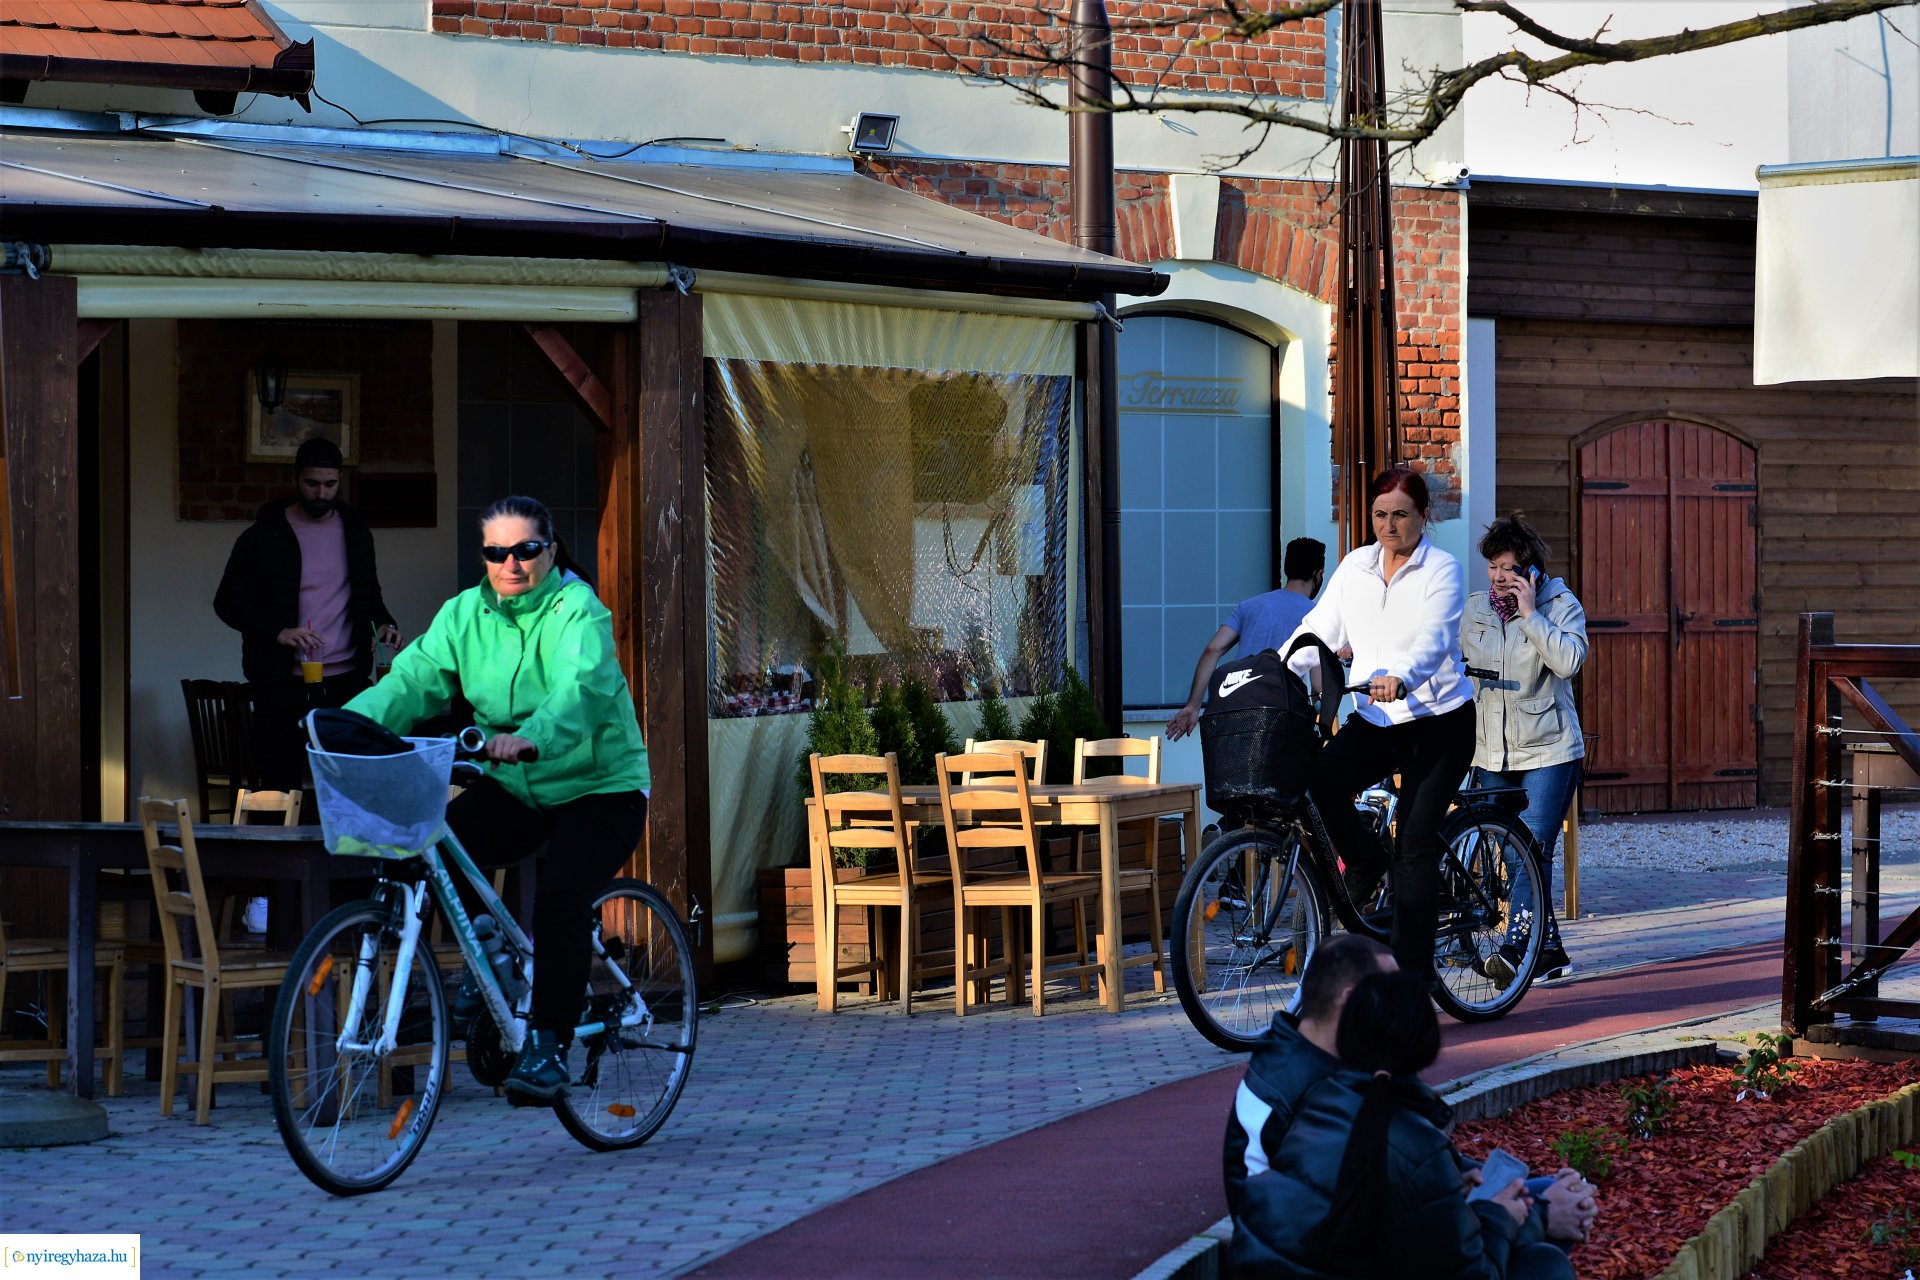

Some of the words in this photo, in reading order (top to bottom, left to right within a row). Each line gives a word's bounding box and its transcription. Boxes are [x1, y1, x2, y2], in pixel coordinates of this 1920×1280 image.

[1128, 371, 1241, 406] Terrazza
[1224, 669, 1253, 686] NIKE
[437, 869, 482, 957] ALPINA
